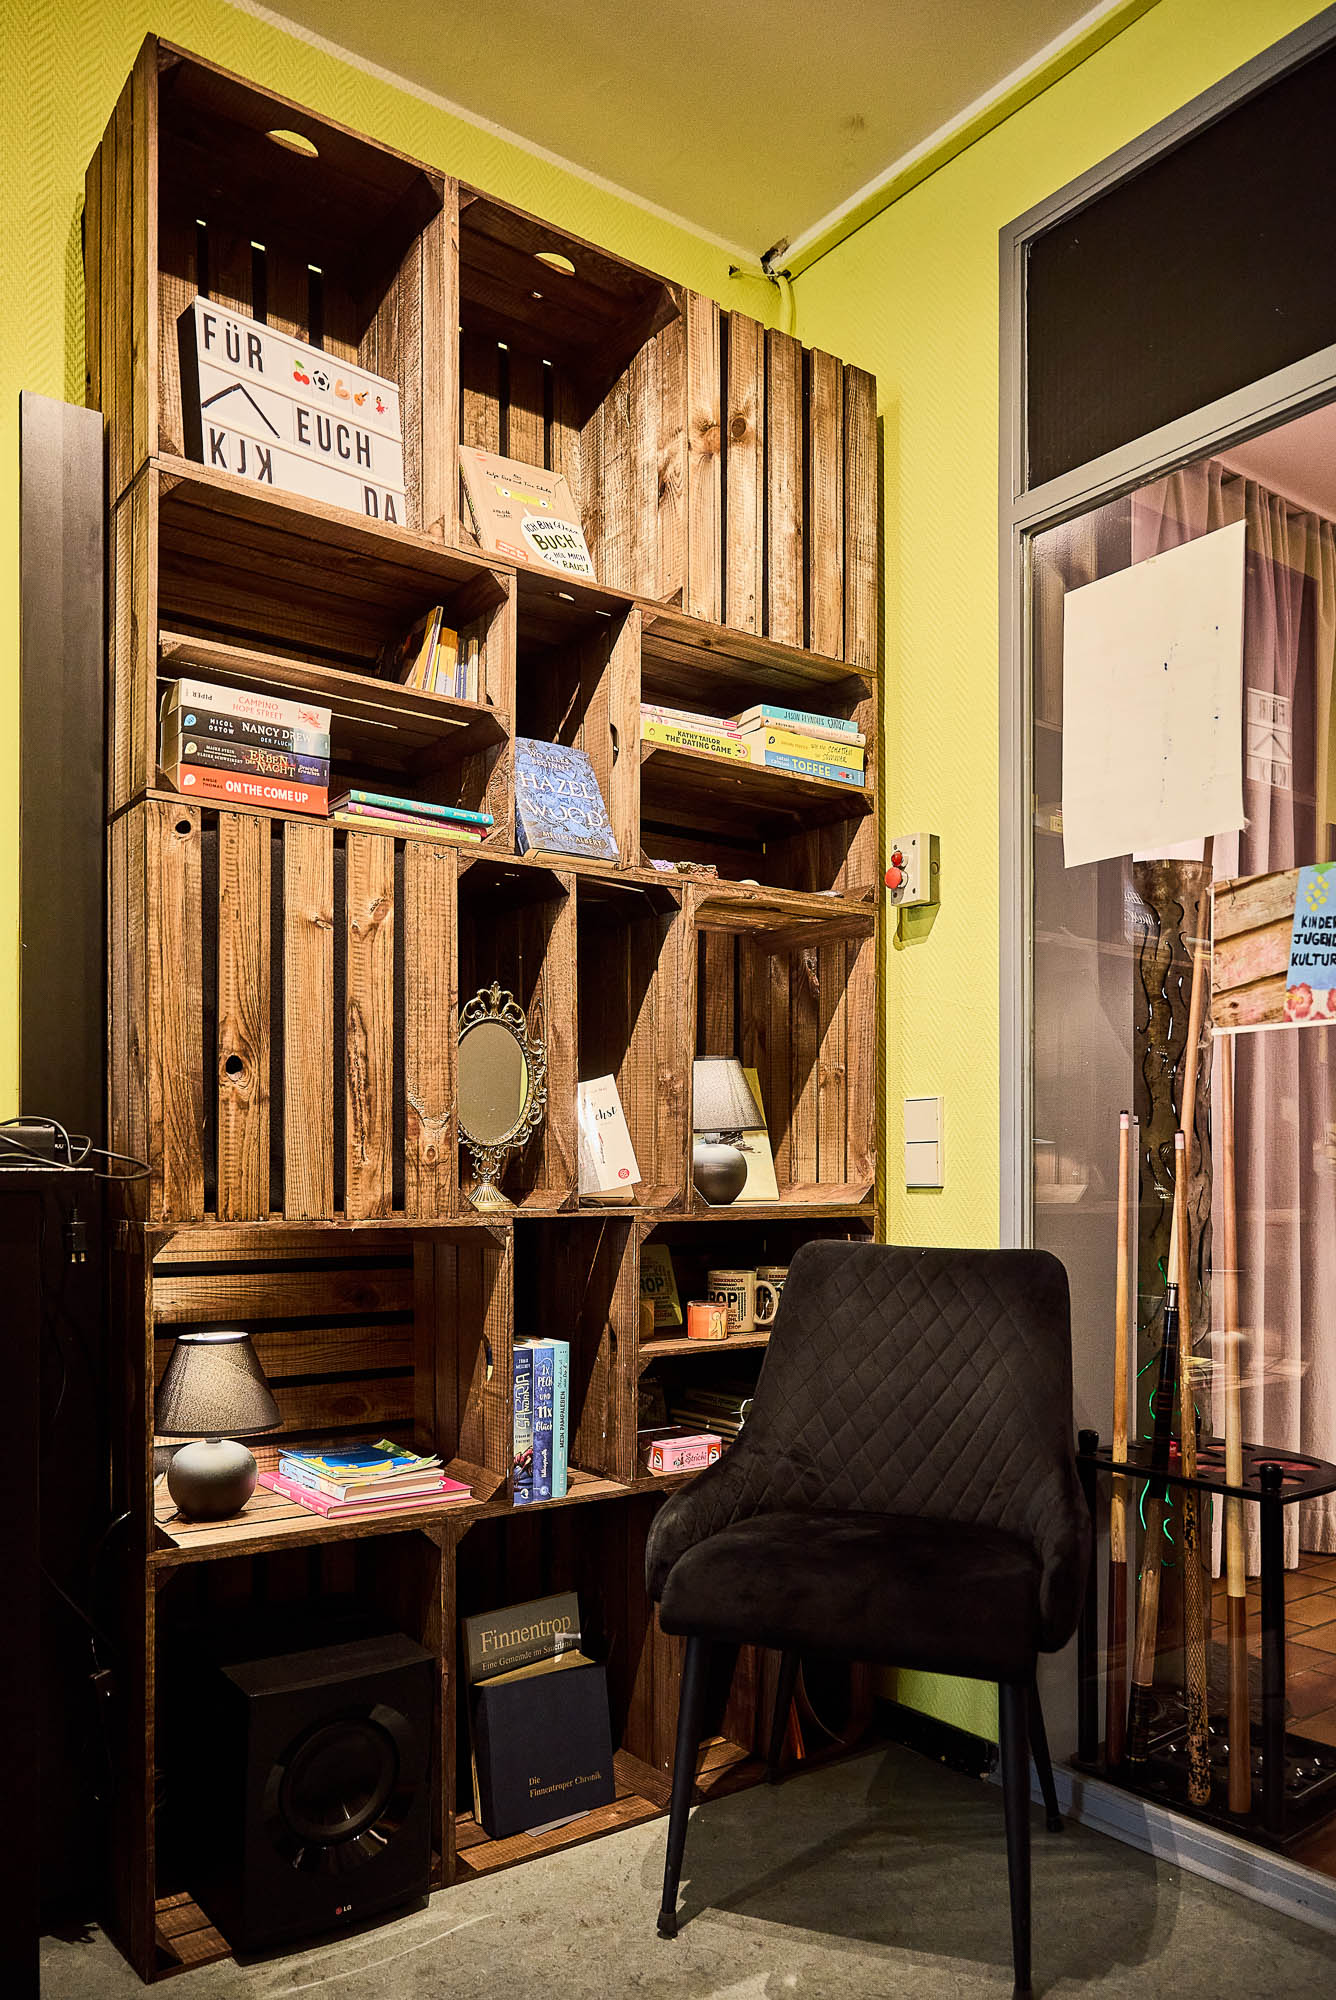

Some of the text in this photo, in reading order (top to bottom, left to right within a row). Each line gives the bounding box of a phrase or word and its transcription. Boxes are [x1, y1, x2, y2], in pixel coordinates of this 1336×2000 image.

[203, 312, 264, 373] FÜR
[296, 407, 371, 469] EUCH
[363, 485, 397, 523] DA
[537, 520, 554, 530] BIN
[232, 703, 283, 720] HOPE STREET
[238, 696, 279, 711] CAMPINO
[208, 725, 235, 735] OSTOW
[273, 738, 292, 747] FLUCH
[241, 721, 280, 737] NANCY
[282, 728, 312, 743] DREW
[677, 730, 721, 745] KATHY TAILOR
[665, 734, 732, 755] THE DATING GAME
[249, 749, 289, 766] ERBEN
[256, 761, 296, 778] NACHT
[792, 758, 831, 776] TOFFEE
[225, 780, 242, 793] ON
[243, 784, 263, 797] THE
[263, 786, 294, 801] COME
[294, 791, 309, 803] UP
[518, 771, 596, 800] HAZEL
[524, 799, 603, 827] WOOD
[537, 1375, 553, 1388] PECH
[480, 1615, 571, 1653] Finnentrop
[481, 1661, 498, 1672] Eine
[533, 1649, 542, 1657] im
[528, 1776, 541, 1786] Die
[529, 1780, 574, 1798] Finnentroper
[343, 1904, 352, 1912] LG
